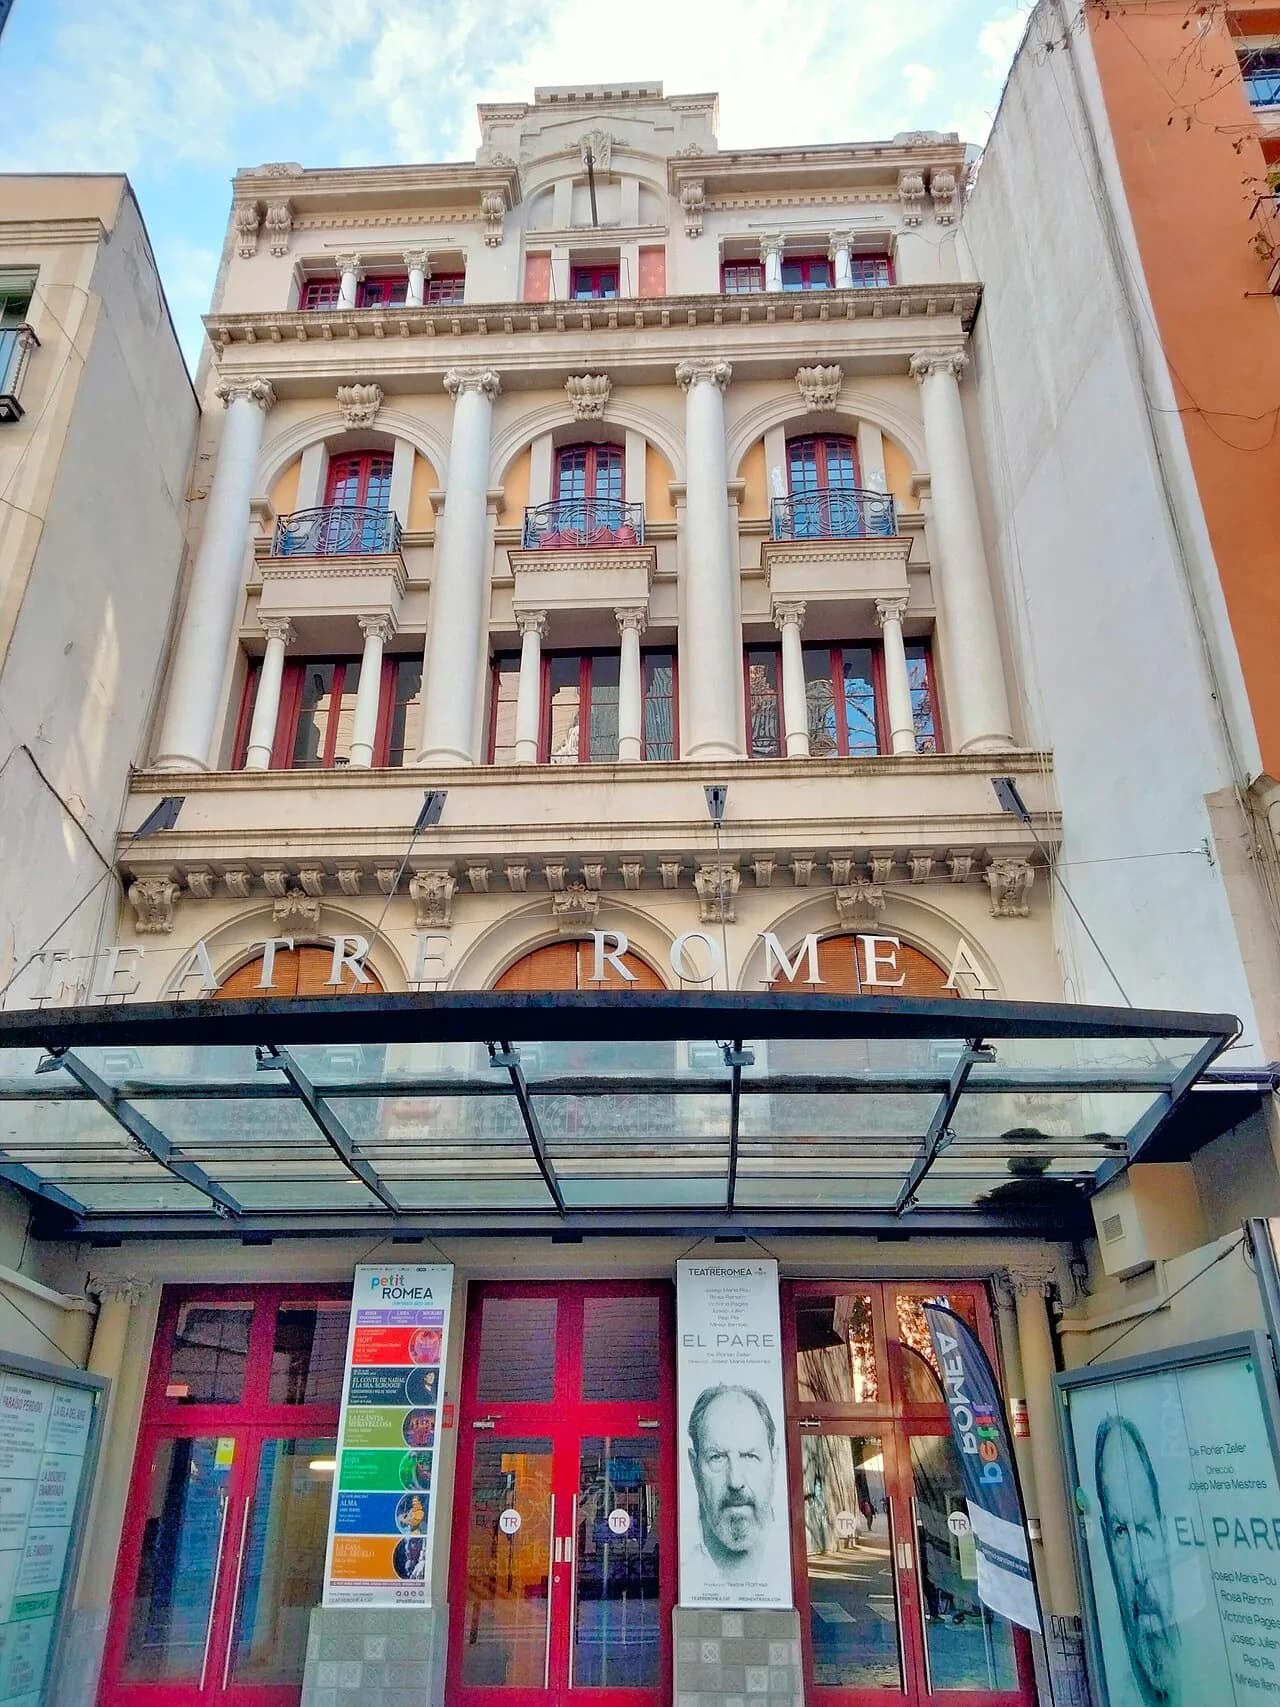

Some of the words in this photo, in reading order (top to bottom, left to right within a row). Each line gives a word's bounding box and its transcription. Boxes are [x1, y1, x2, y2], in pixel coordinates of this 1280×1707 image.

[29, 932, 453, 999] TEATRE
[587, 929, 998, 992] ROMEA
[688, 1268, 752, 1276] TEATREROMEA
[370, 1273, 405, 1290] petit
[381, 1287, 433, 1299] ROMEA
[683, 1334, 706, 1347] EL
[717, 1334, 775, 1347] PARE
[1232, 1480, 1267, 1489] Mestres
[340, 1499, 357, 1507] ALMA
[503, 1517, 518, 1528] TR
[611, 1517, 627, 1528] TR
[837, 1518, 855, 1530] TR
[949, 1519, 967, 1530] TR
[1174, 1516, 1205, 1546] EL
[1259, 1573, 1276, 1586] Pou
[1220, 1589, 1241, 1603] Rosa
[1243, 1654, 1260, 1668] Pep
